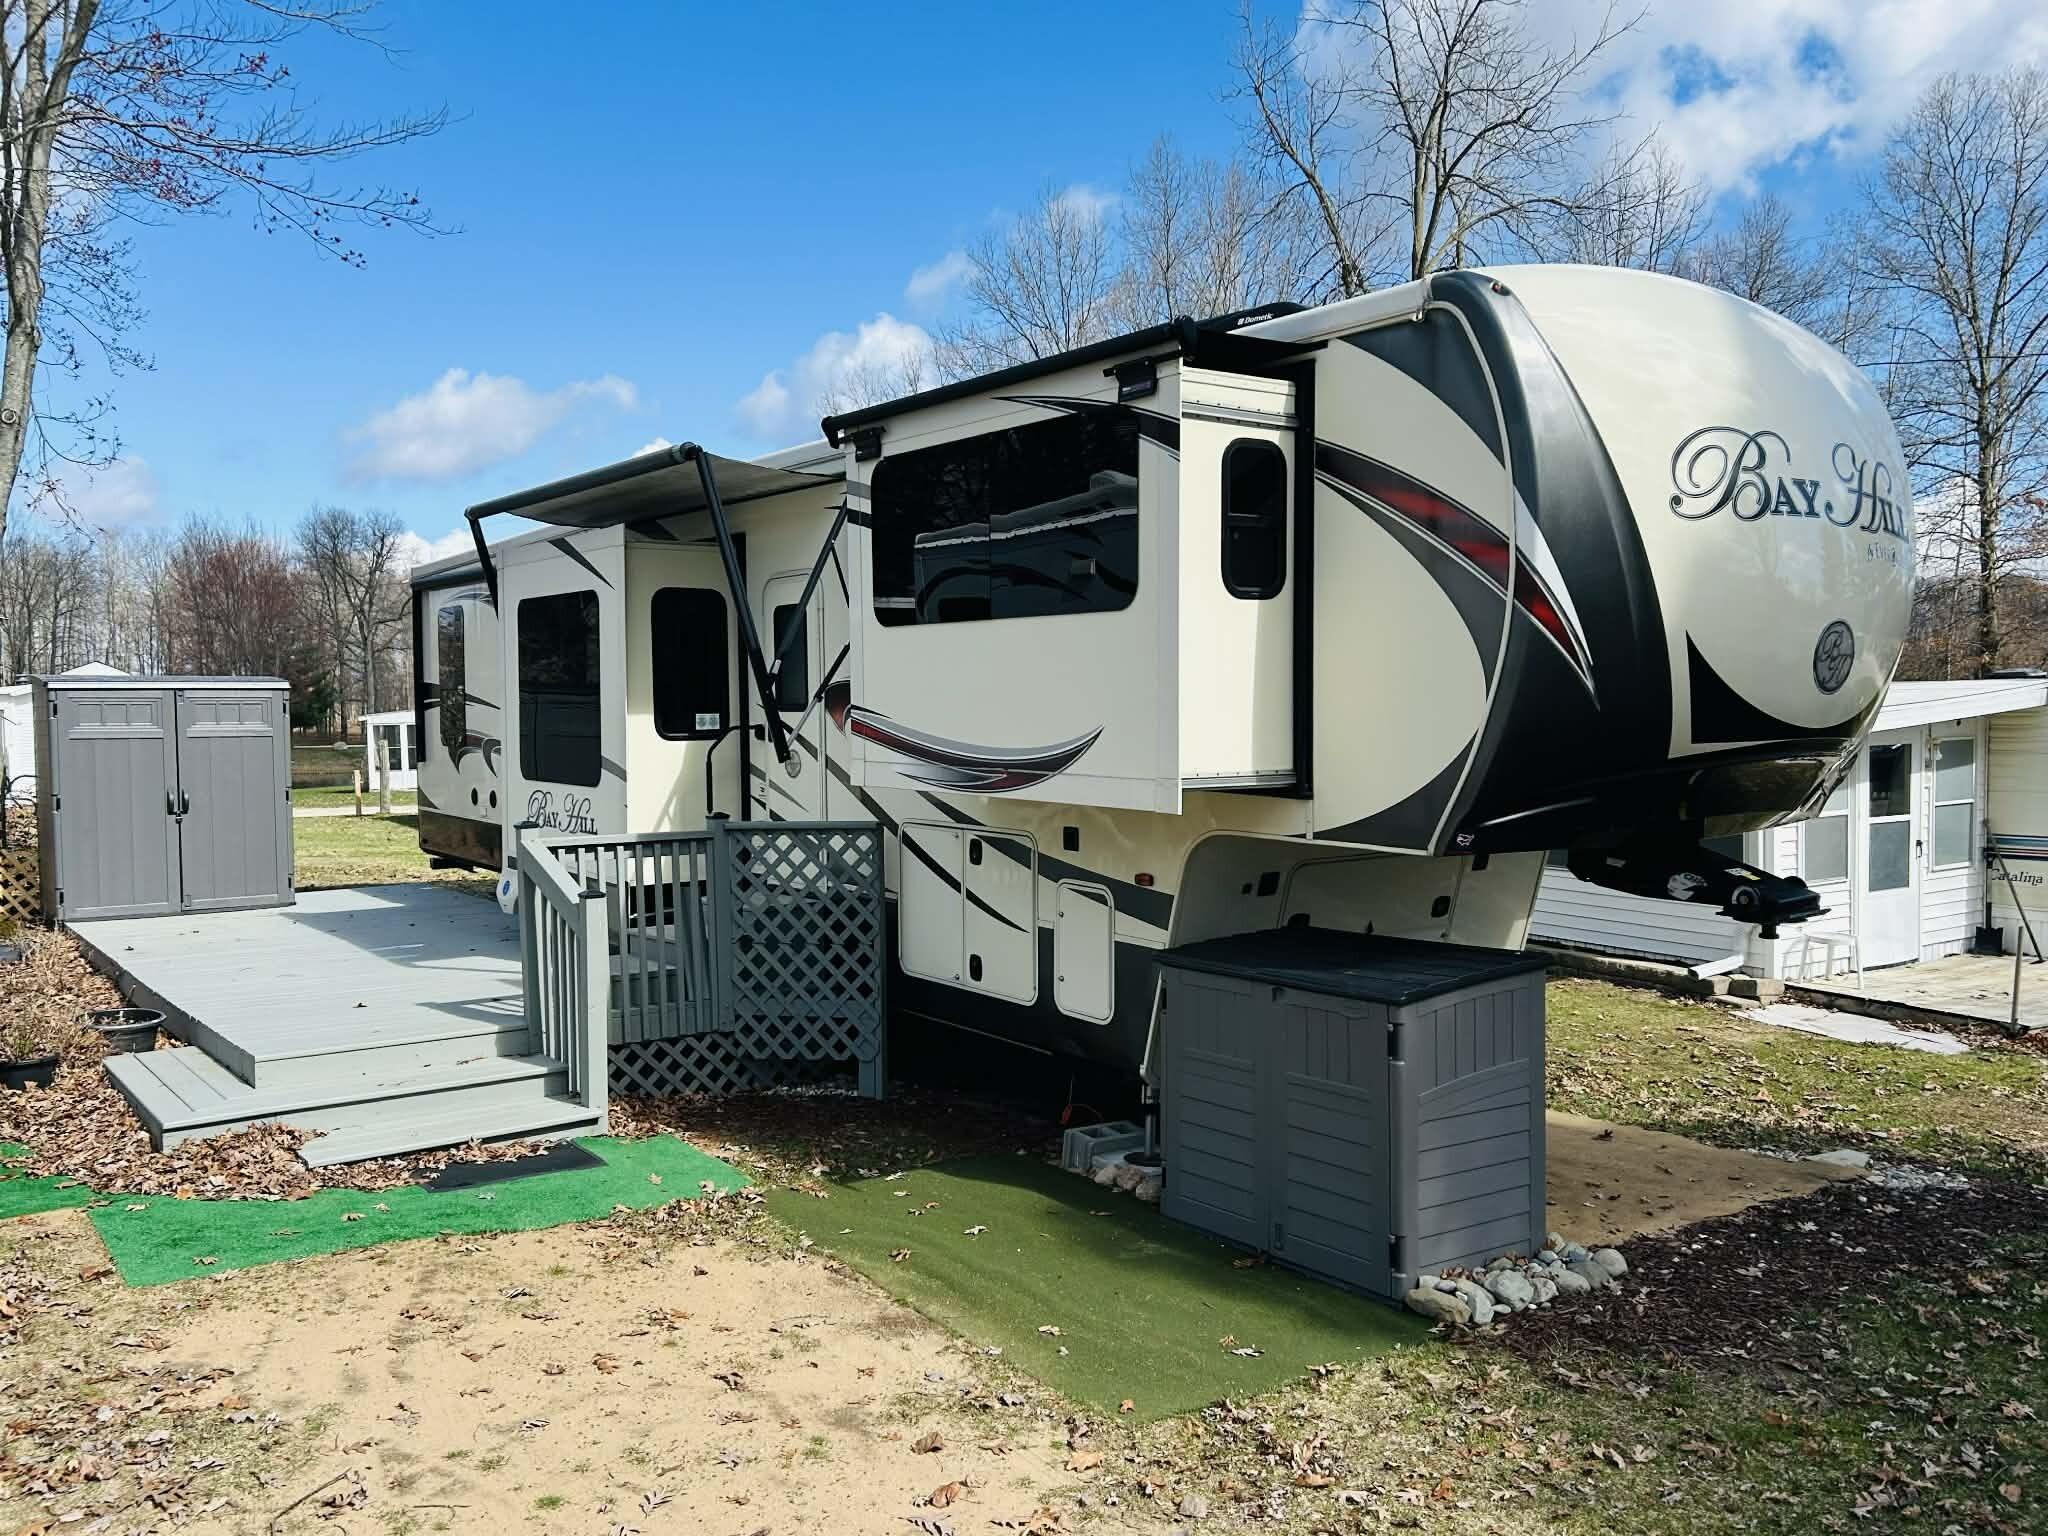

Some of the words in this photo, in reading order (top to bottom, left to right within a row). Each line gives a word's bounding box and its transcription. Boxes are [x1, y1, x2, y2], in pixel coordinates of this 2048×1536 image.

[1245, 312, 1274, 324] Dometic
[1670, 426, 1821, 522] BAY
[559, 793, 598, 836] HILL
